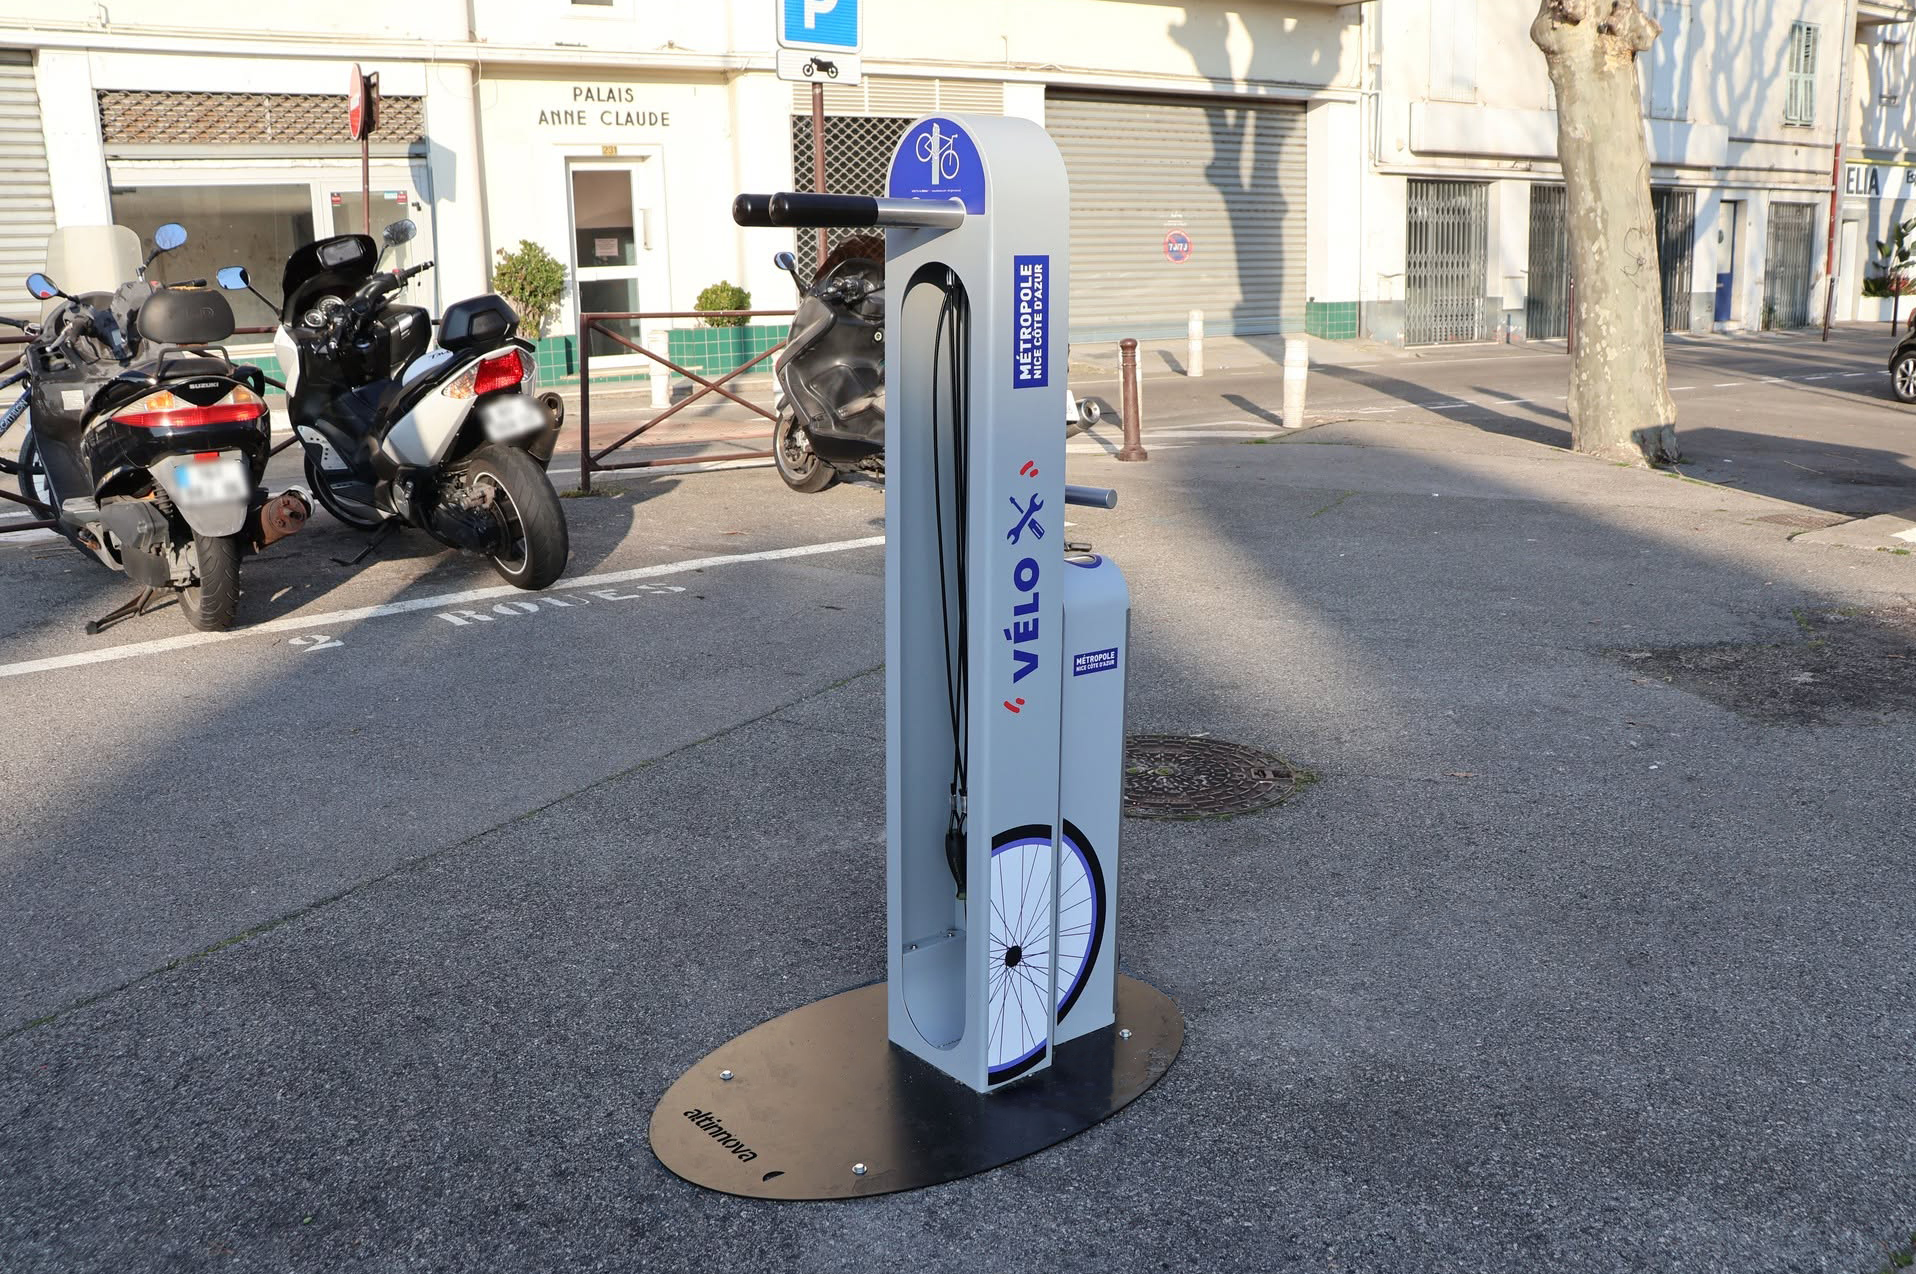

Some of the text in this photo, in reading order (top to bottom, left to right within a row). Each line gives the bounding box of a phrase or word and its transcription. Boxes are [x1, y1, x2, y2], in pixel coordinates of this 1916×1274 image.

[803, 0, 839, 30] P
[573, 86, 635, 103] PALAIS
[538, 109, 670, 127] ANNE CLAUDE
[602, 145, 618, 155] 231
[1016, 264, 1033, 380] MÉTROPOLE
[1031, 263, 1043, 379] NICE CÔTE D'AZUR
[189, 382, 219, 390] SUZUKI
[288, 582, 687, 653] 2 ROUES
[1003, 557, 1040, 684] VÉLO
[1076, 651, 1115, 666] MÉTROPOLE
[1076, 664, 1087, 672] NICE
[683, 1108, 758, 1163] altinnova
